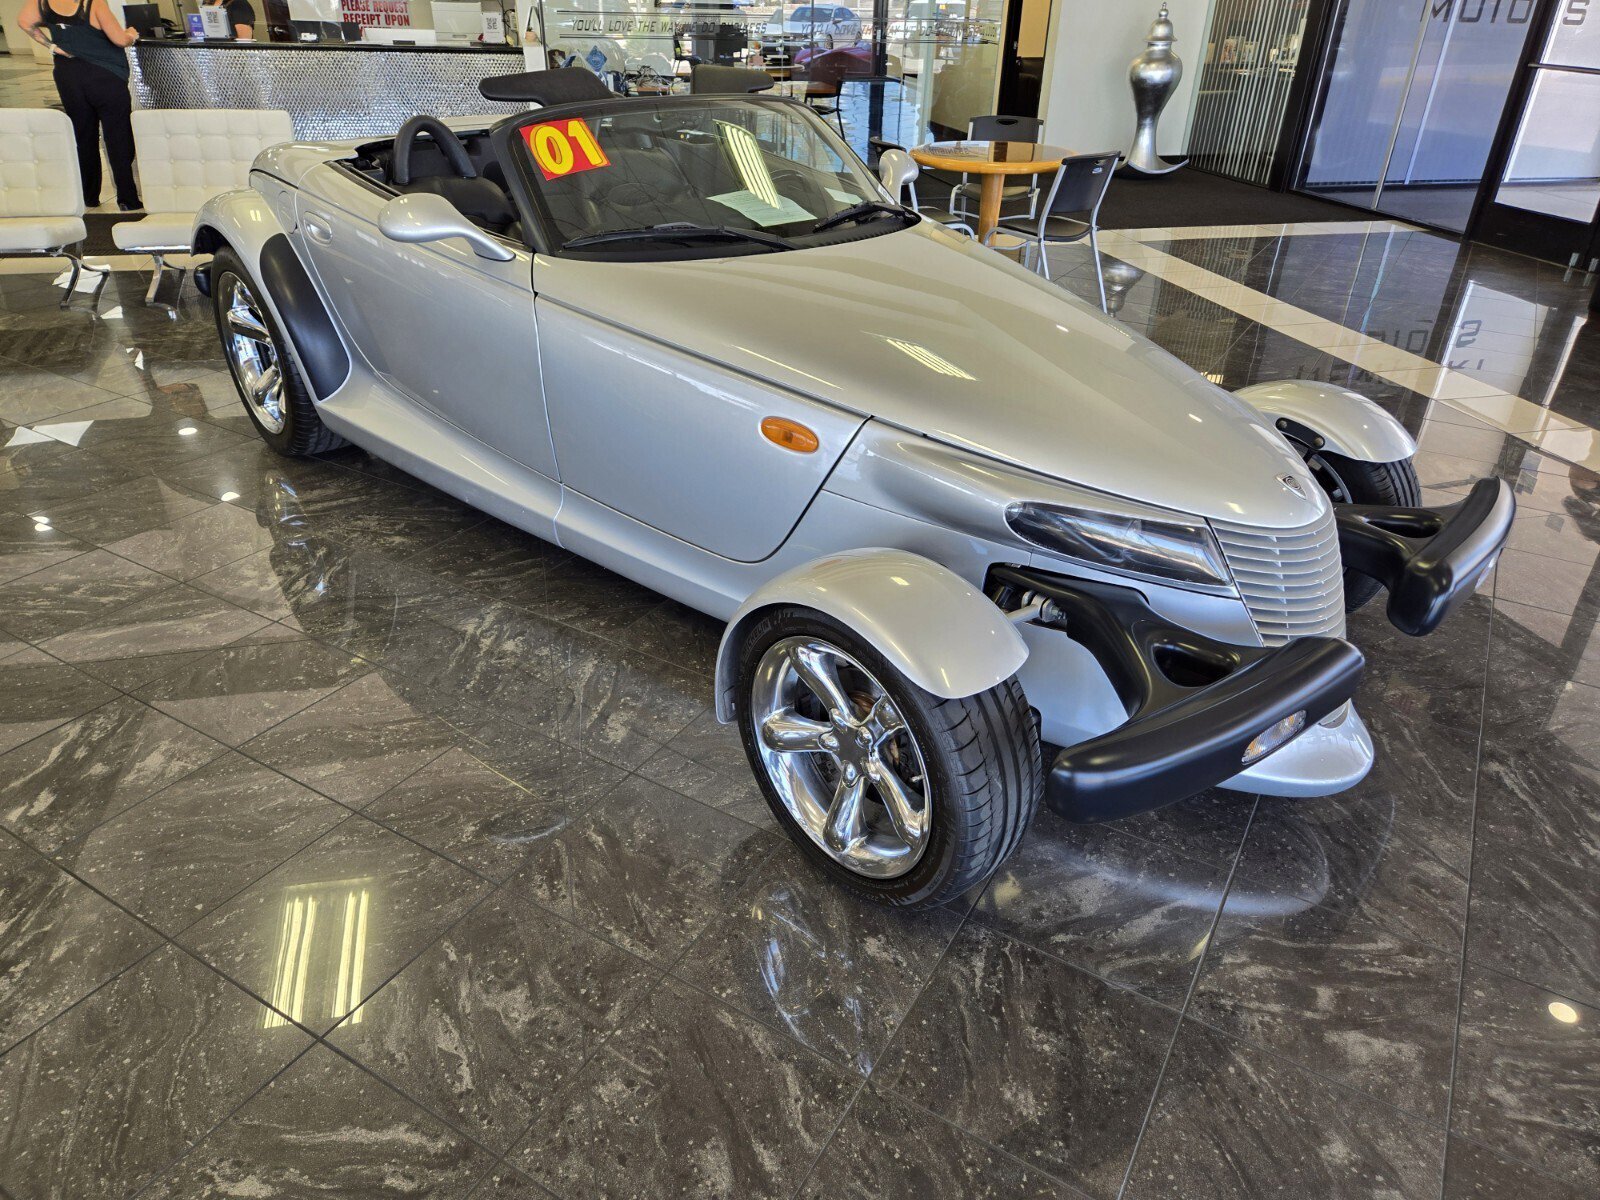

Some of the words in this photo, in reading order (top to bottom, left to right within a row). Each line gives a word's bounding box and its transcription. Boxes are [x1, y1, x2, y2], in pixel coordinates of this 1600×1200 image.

[341, 0, 370, 12] PLEASE
[373, 1, 408, 13] REQUEST
[343, 13, 381, 26] RECEIPT
[385, 14, 410, 26] UPON
[572, 19, 603, 31] YOU'LL
[608, 20, 634, 32] LOVE
[638, 21, 657, 32] THE
[701, 22, 716, 33] DO
[529, 120, 608, 175] 01
